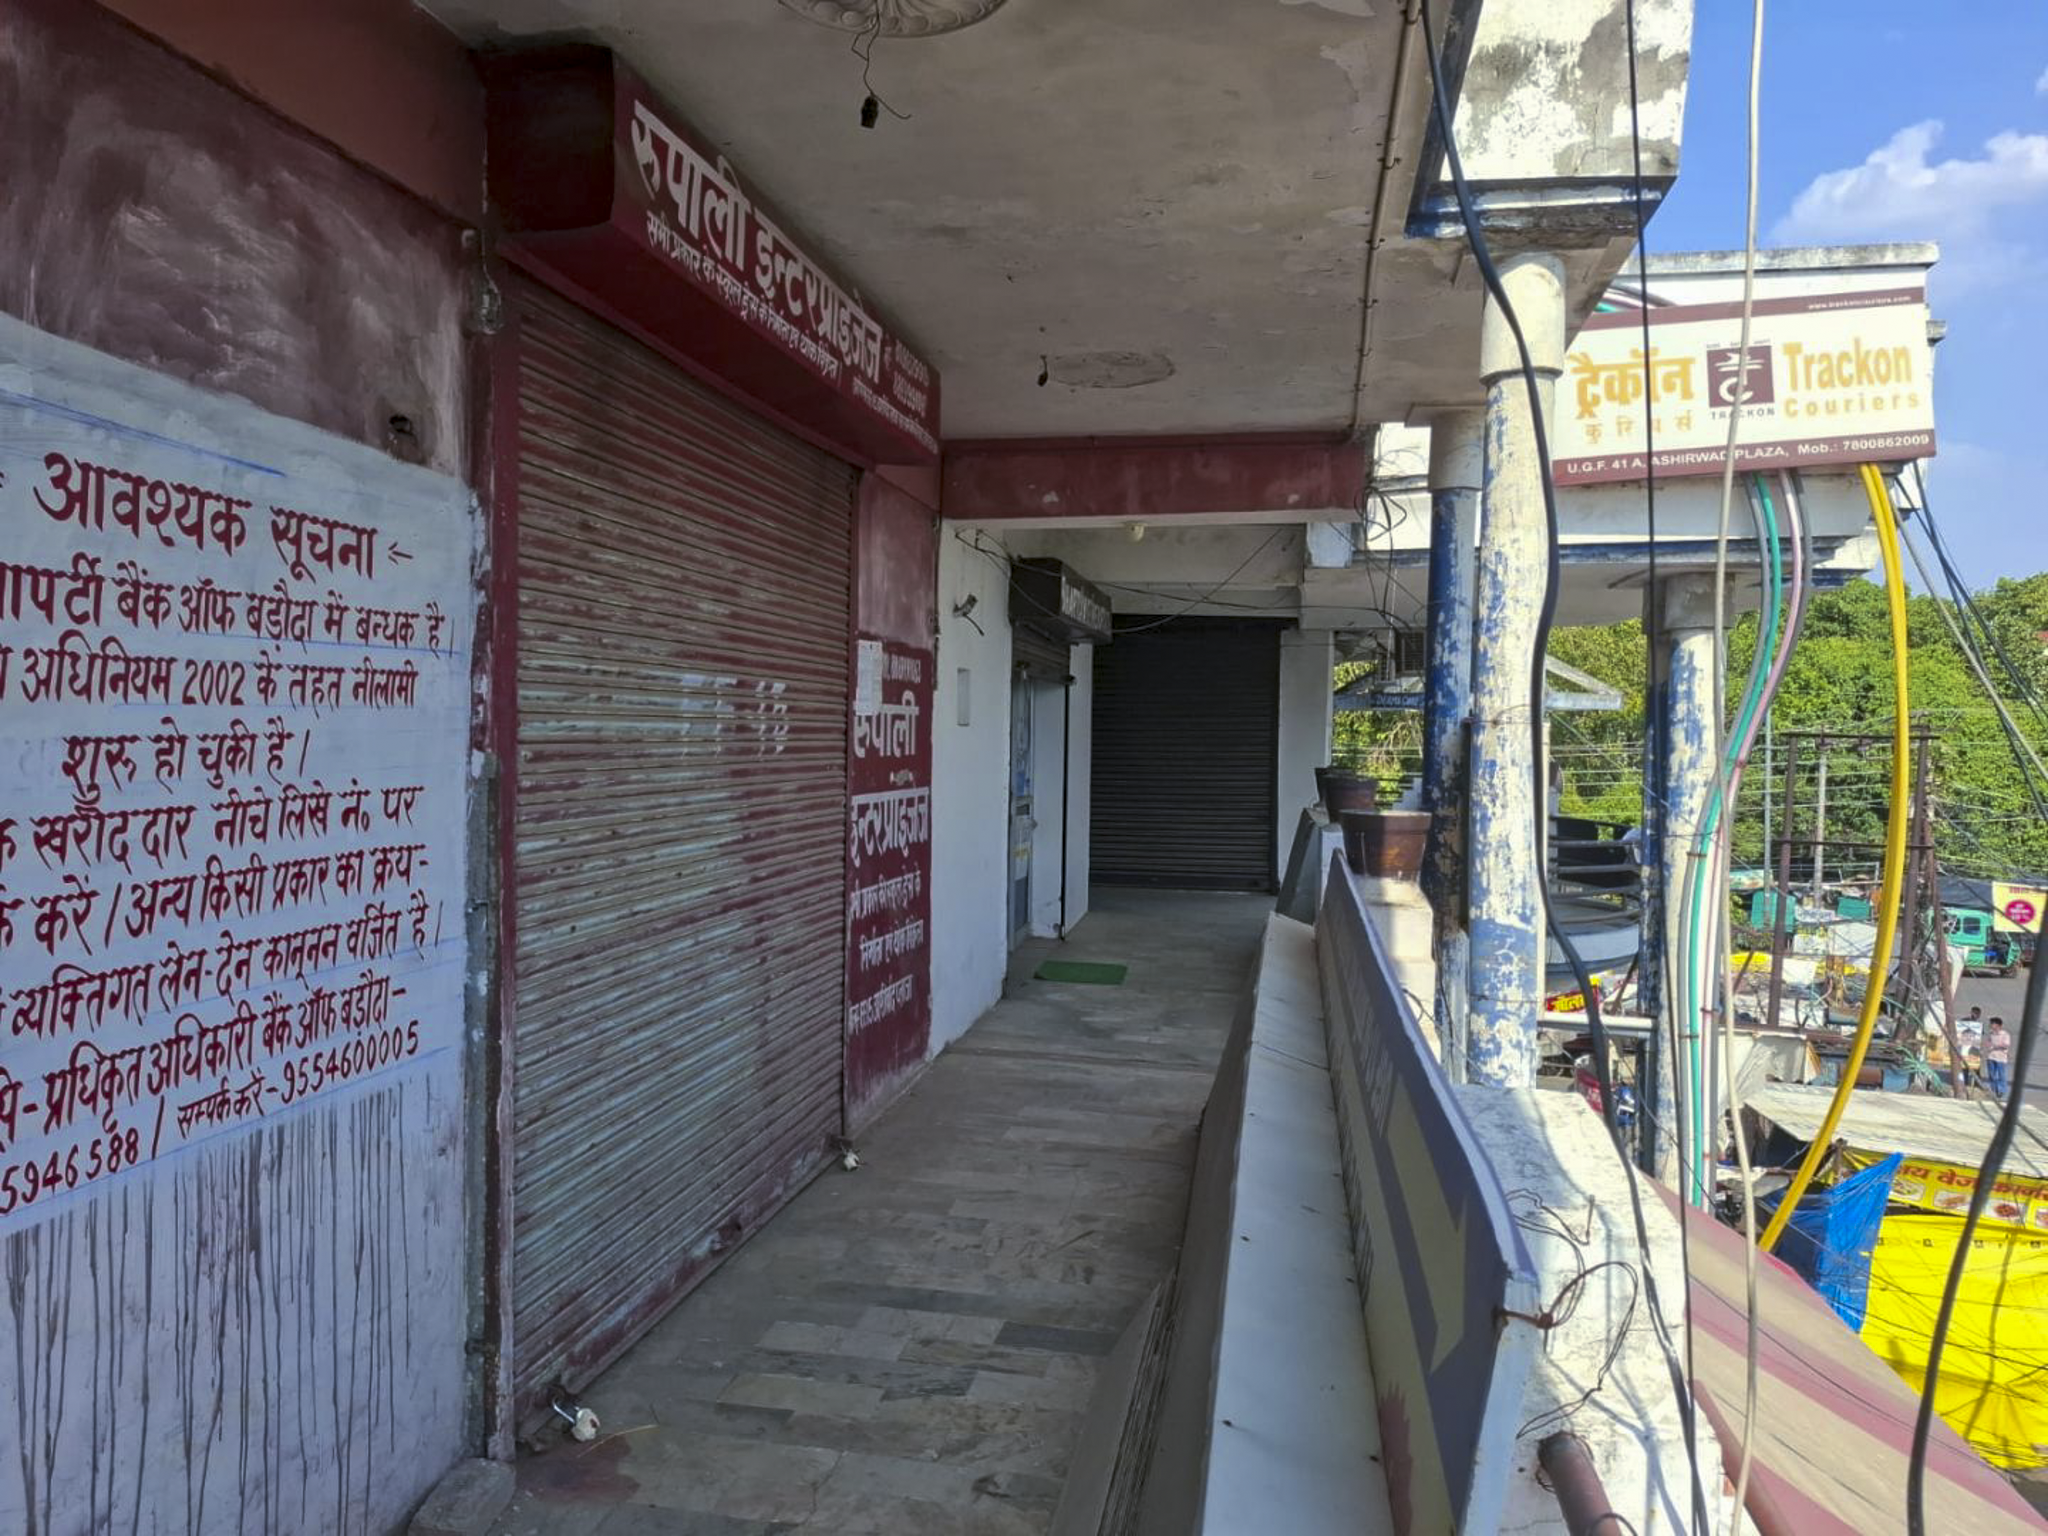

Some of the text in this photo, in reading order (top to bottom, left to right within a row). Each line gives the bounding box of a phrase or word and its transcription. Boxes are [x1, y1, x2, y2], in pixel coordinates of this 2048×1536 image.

[1782, 336, 1912, 392] Trackon
[1784, 392, 1918, 418] Couriers
[33, 452, 377, 584] आवश्यक सूचना
[111, 560, 174, 630] बैंक
[178, 578, 241, 634] ऑफ
[323, 590, 349, 644] में
[355, 607, 419, 649] बन्धक
[20, 629, 178, 705] अधिनियम
[182, 659, 245, 706] 2002
[254, 650, 283, 706] के
[287, 663, 345, 719] तहत
[351, 656, 419, 711] नीलामी
[148, 716, 188, 795] हो
[196, 719, 258, 790] चुकी
[211, 786, 273, 850] नीचे
[279, 780, 332, 841] लिखे
[381, 786, 424, 828] पर
[125, 875, 197, 938] अन्य
[203, 852, 268, 923] किसी
[273, 856, 330, 913] प्रकार
[336, 850, 364, 896] का
[9, 963, 155, 1039] व्यक्तिगत
[263, 923, 341, 991] कानूनन
[346, 901, 401, 960] वर्जित
[148, 1000, 258, 1095] अधिकारी
[262, 991, 293, 1057] बैंक
[295, 987, 336, 1049] ऑफ
